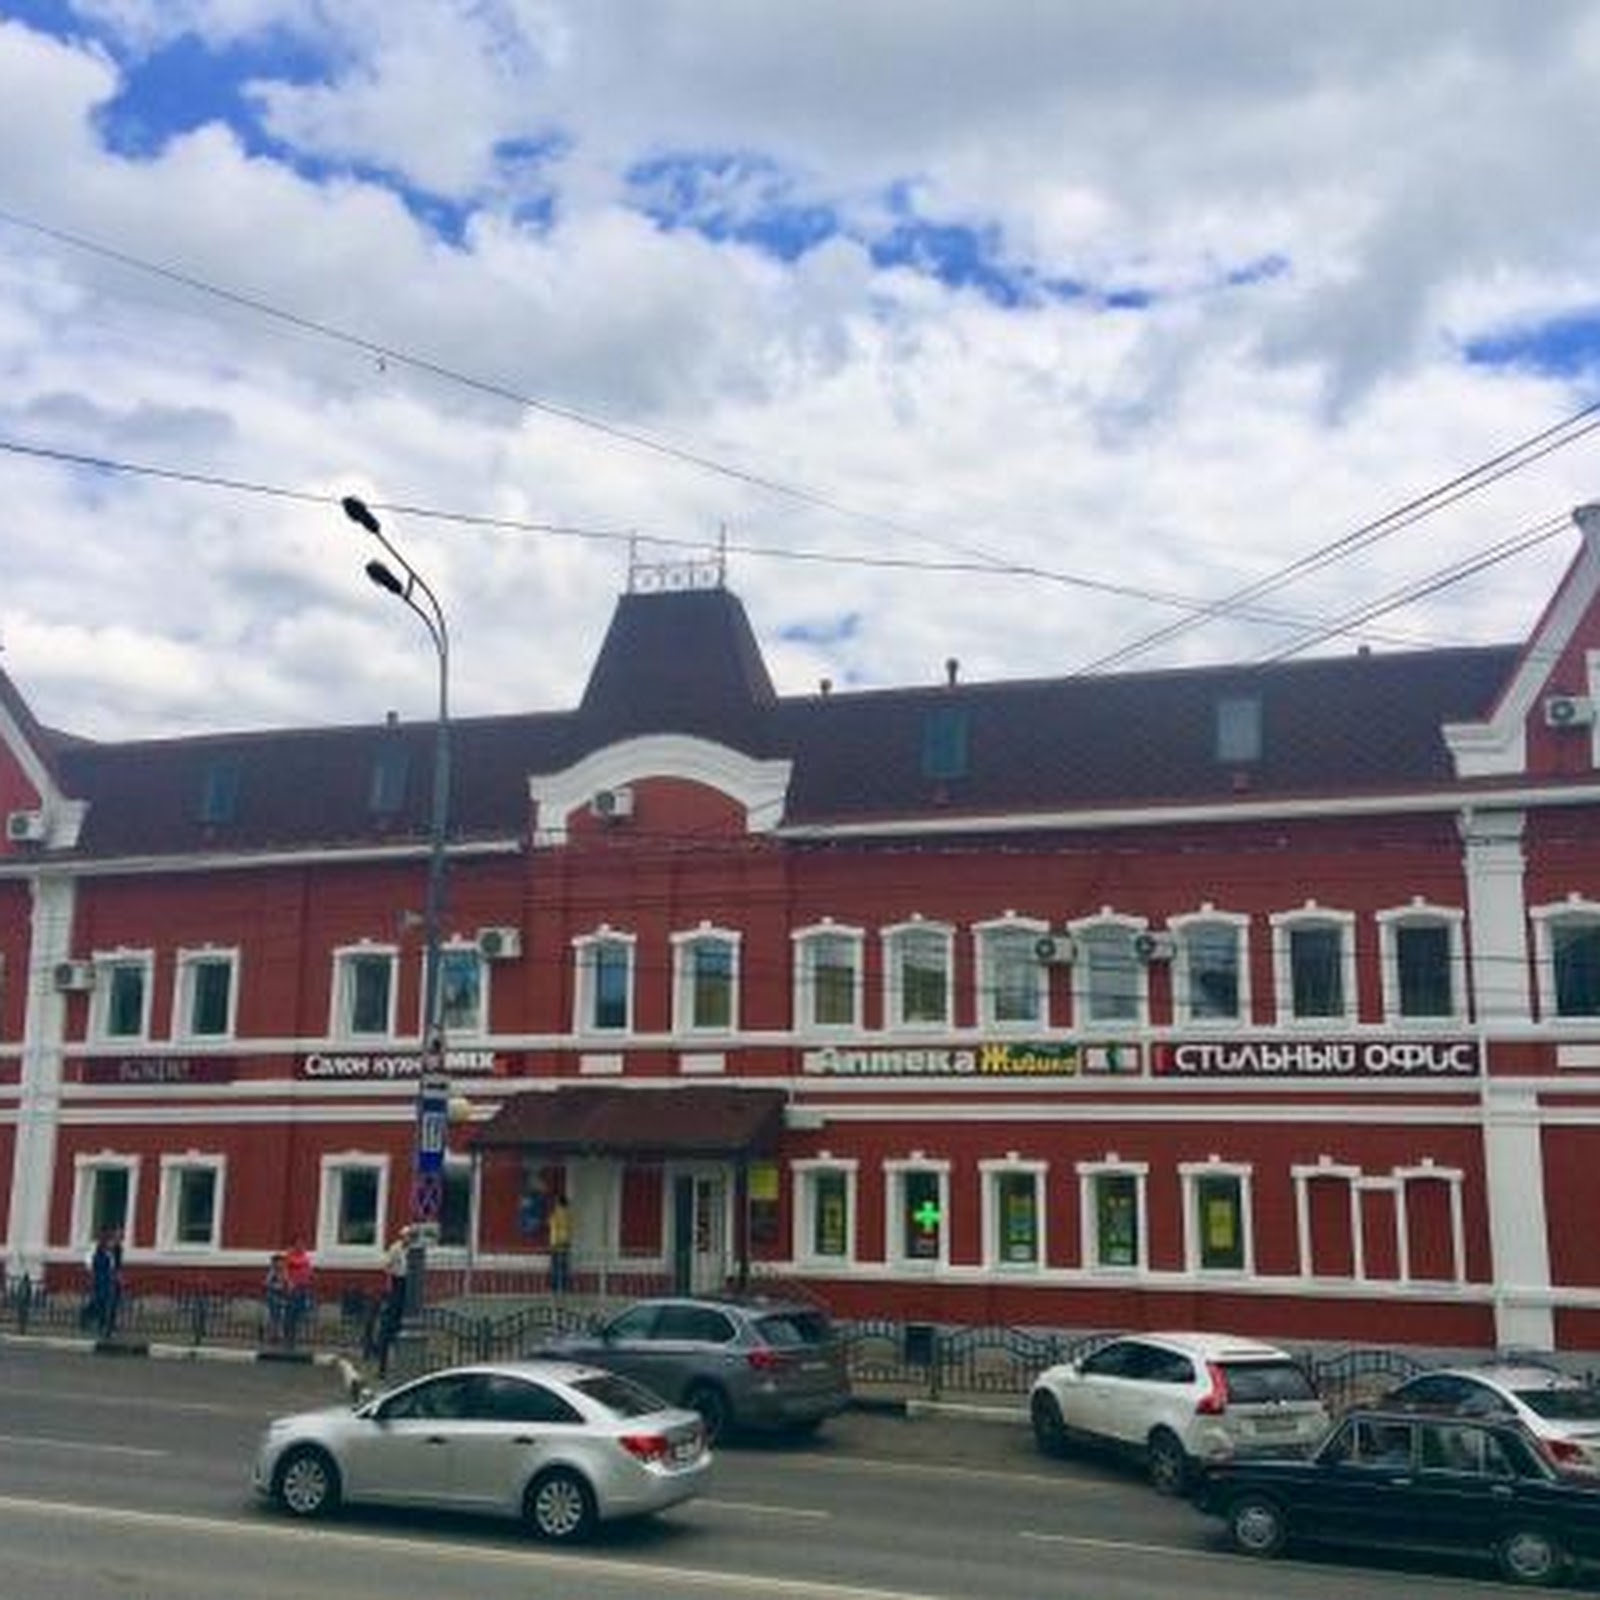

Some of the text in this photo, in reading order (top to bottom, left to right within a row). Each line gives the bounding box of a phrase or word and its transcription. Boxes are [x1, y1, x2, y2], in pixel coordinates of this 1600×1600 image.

[372, 1055, 437, 1079] кухн
[818, 1046, 976, 1074] Аптека
[1174, 1043, 1474, 1072] СТИЛЬНЫЙ ОФИС
